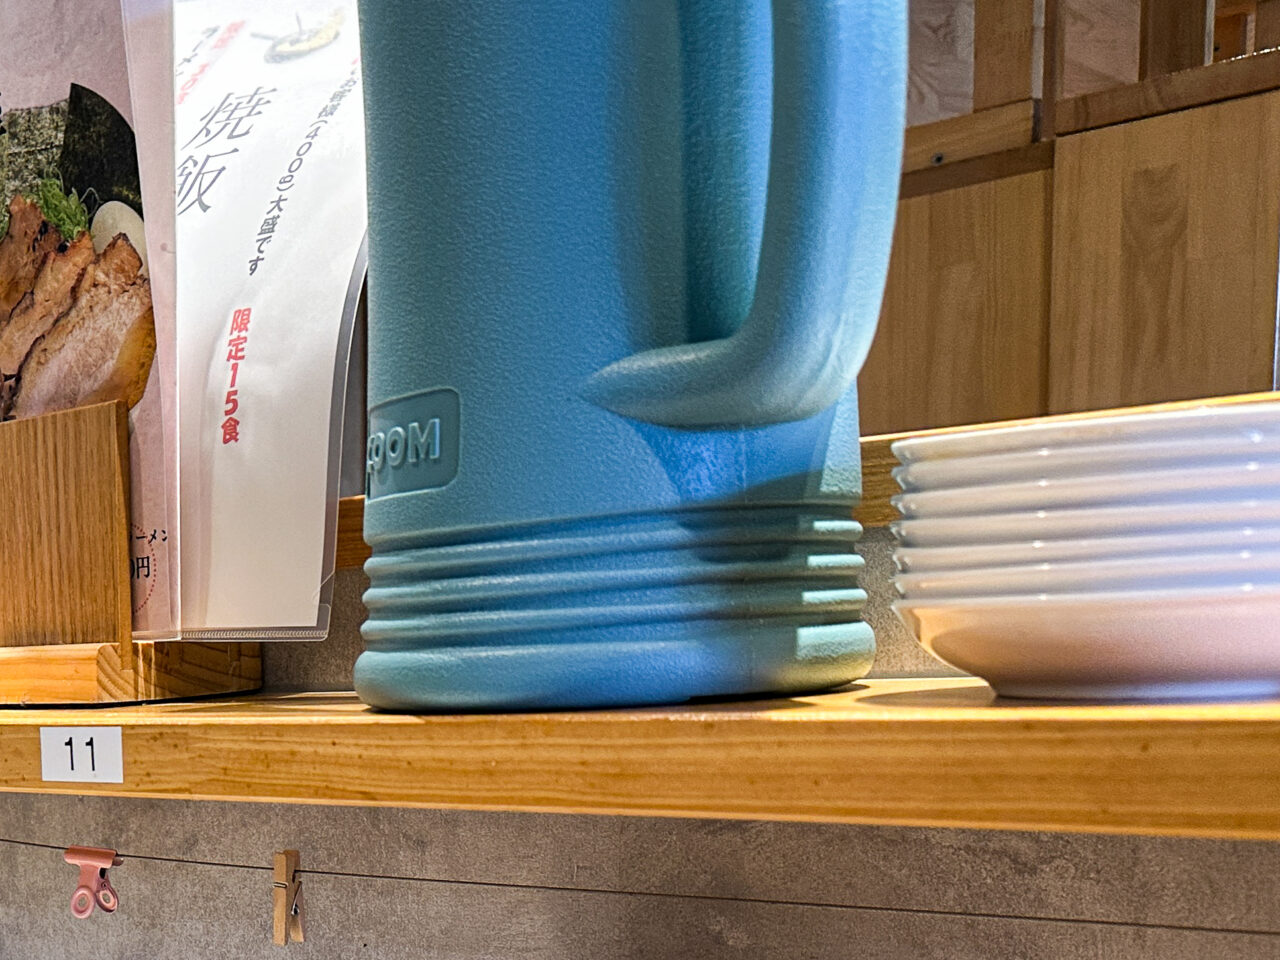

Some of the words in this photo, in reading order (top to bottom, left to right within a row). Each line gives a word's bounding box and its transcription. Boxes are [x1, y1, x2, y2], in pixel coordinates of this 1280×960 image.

[177, 86, 277, 215] 焼飯
[220, 308, 252, 445] 限定15食
[64, 737, 95, 772] 11
